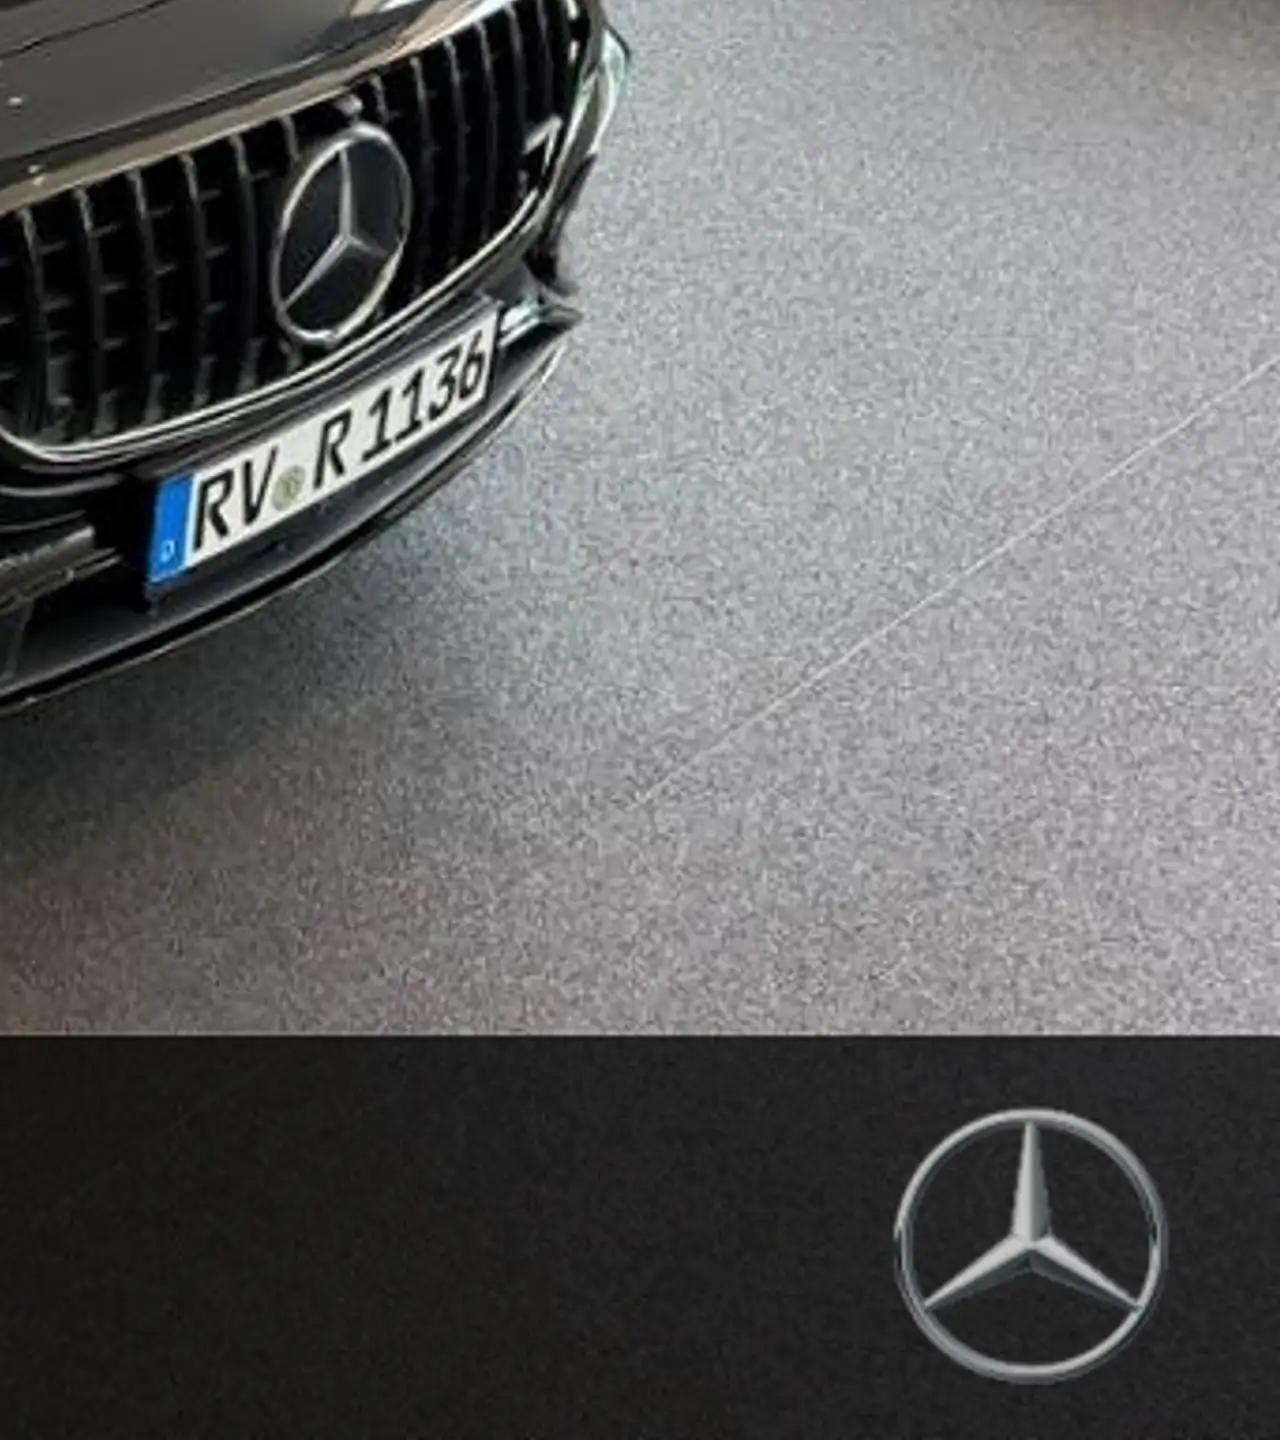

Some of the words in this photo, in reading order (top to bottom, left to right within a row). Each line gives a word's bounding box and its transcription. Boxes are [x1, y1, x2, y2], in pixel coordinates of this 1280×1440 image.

[194, 446, 278, 552] RV
[313, 409, 352, 490] R
[361, 329, 486, 462] 1136
